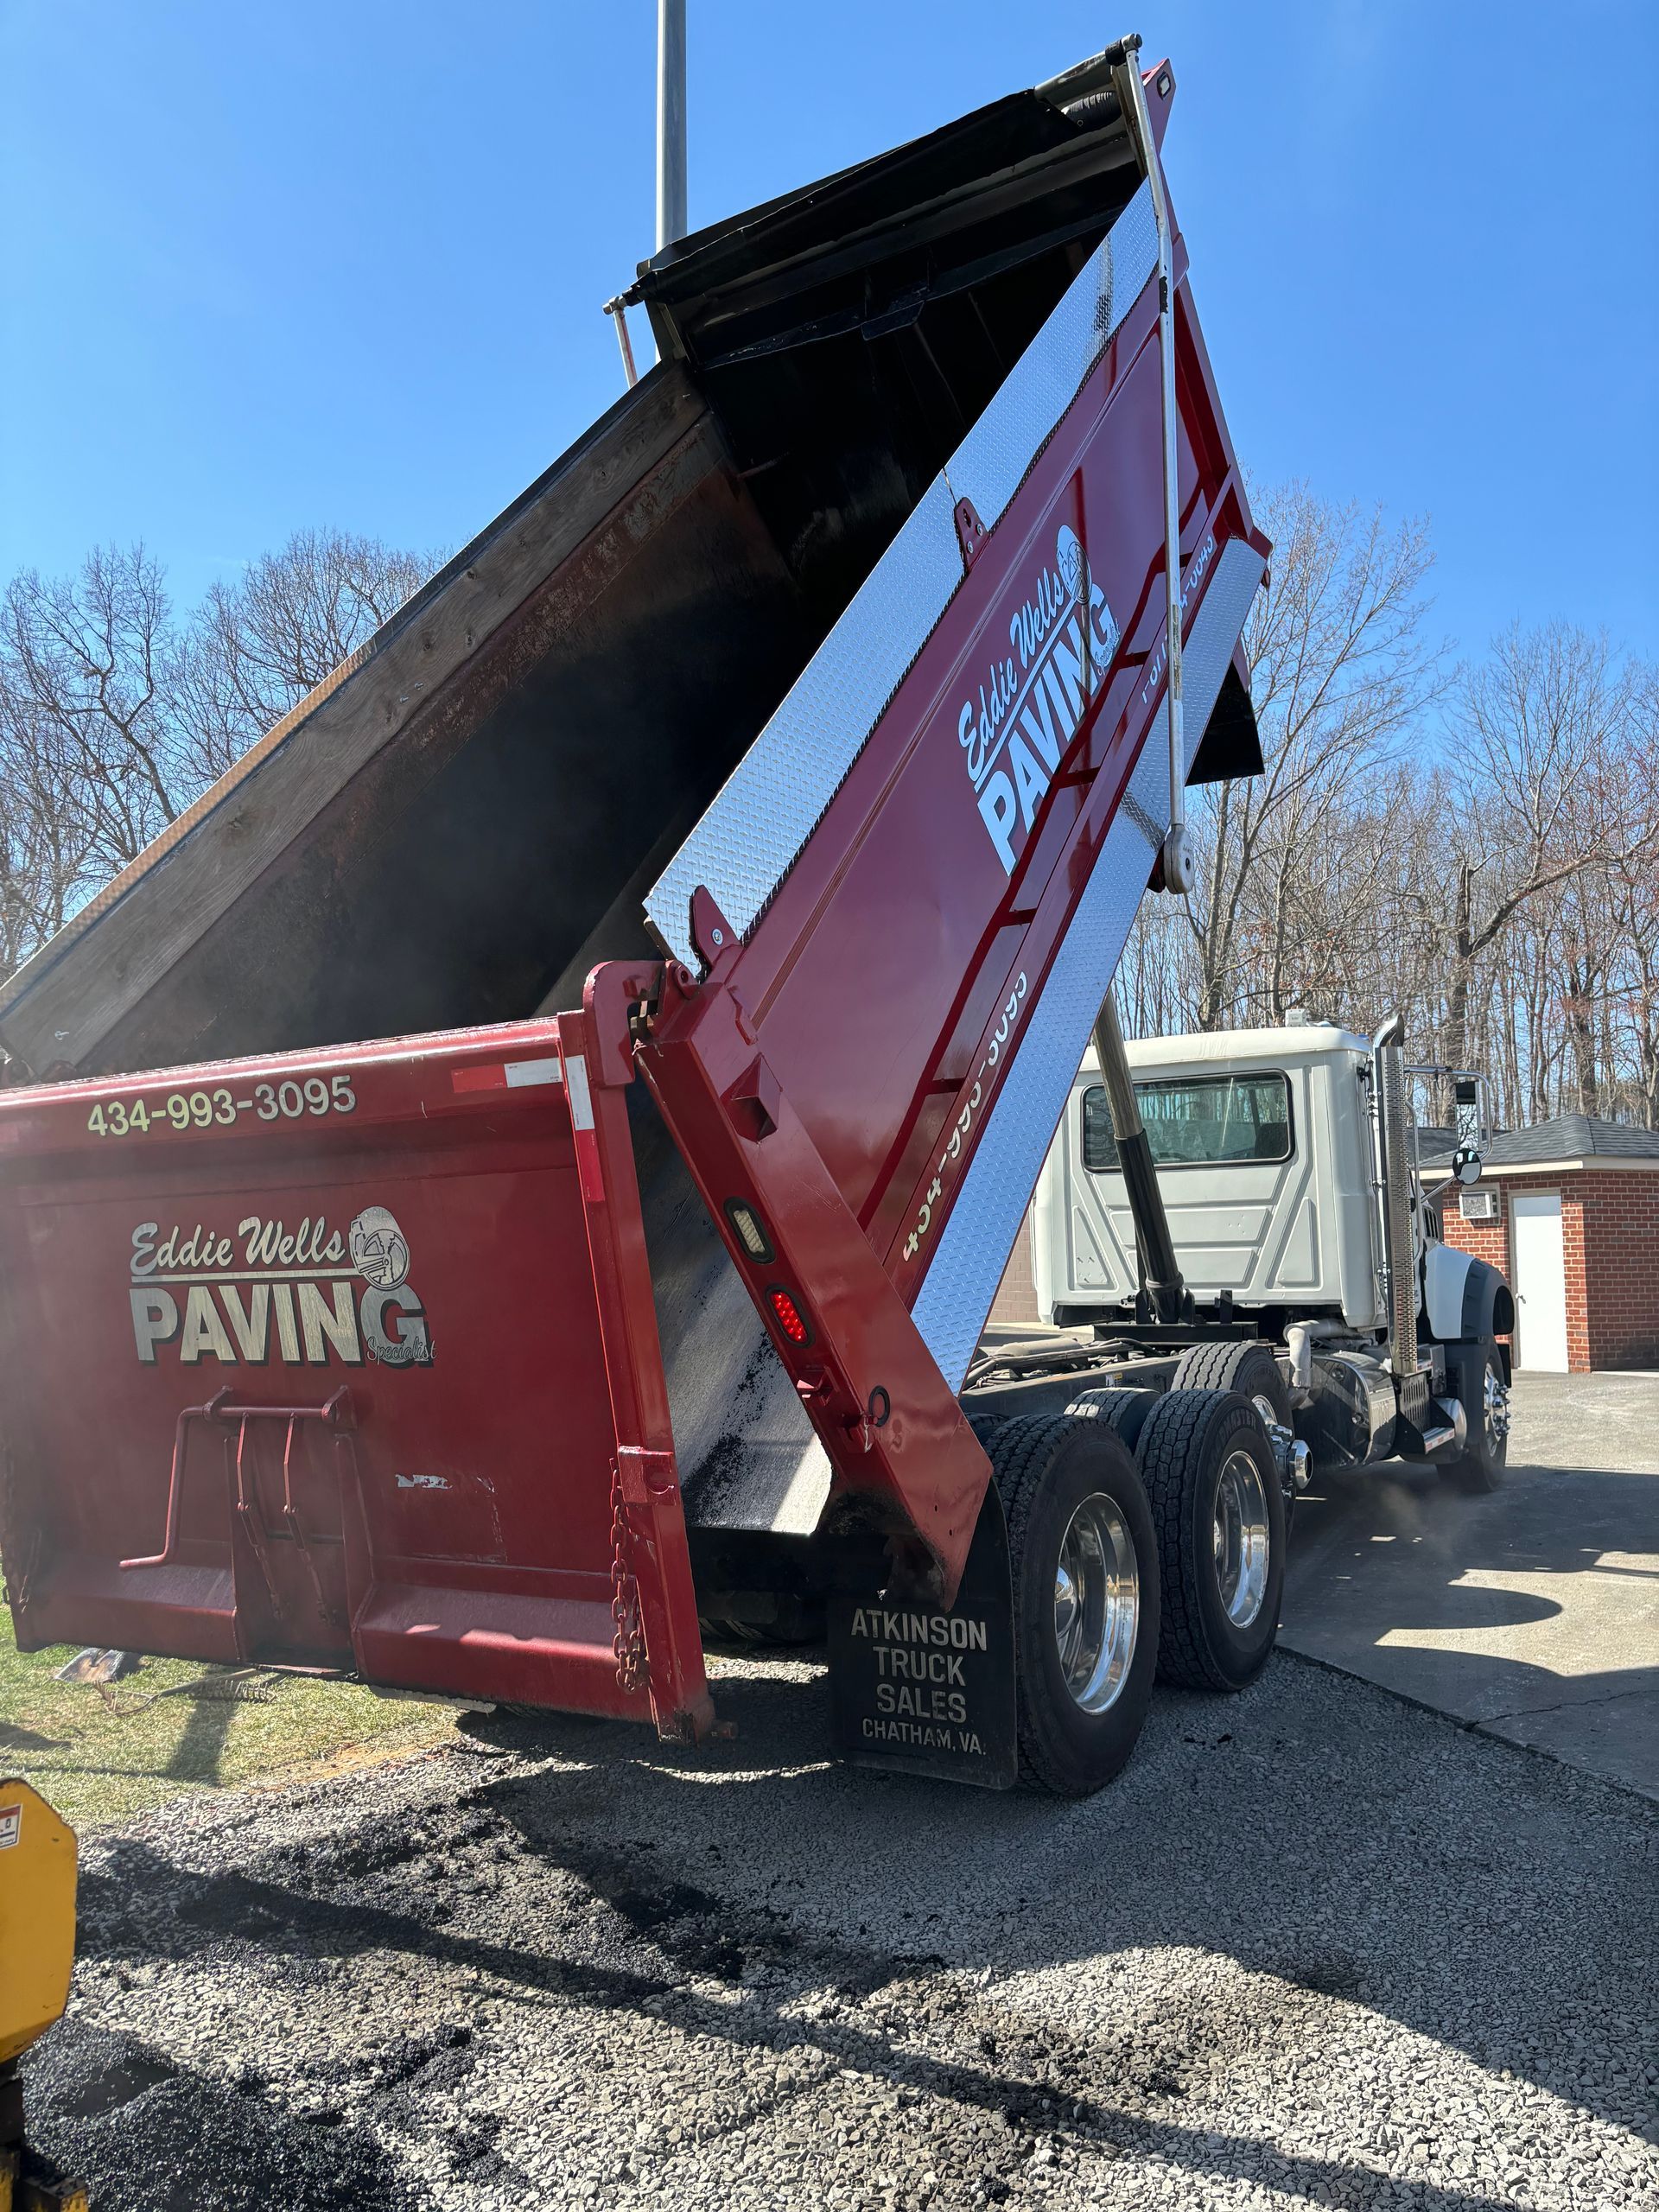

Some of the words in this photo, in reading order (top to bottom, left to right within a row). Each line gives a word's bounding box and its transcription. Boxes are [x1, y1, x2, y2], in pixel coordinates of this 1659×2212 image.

[958, 658, 1018, 782] Eddie
[1009, 567, 1065, 661] Wells
[977, 582, 1120, 878] PAVING
[87, 1075, 356, 1136] 434-993-3095
[130, 1222, 233, 1275] Eddie
[238, 1216, 346, 1265] Wells
[129, 1281, 430, 1365] PAVING
[366, 1336, 437, 1366] Specialist
[850, 1608, 988, 1651] ATKINSON
[873, 1646, 967, 1687] TRUCK
[876, 1683, 967, 1723] SALES
[861, 1717, 956, 1752] CHATHAM,
[958, 1732, 987, 1756] VA.
